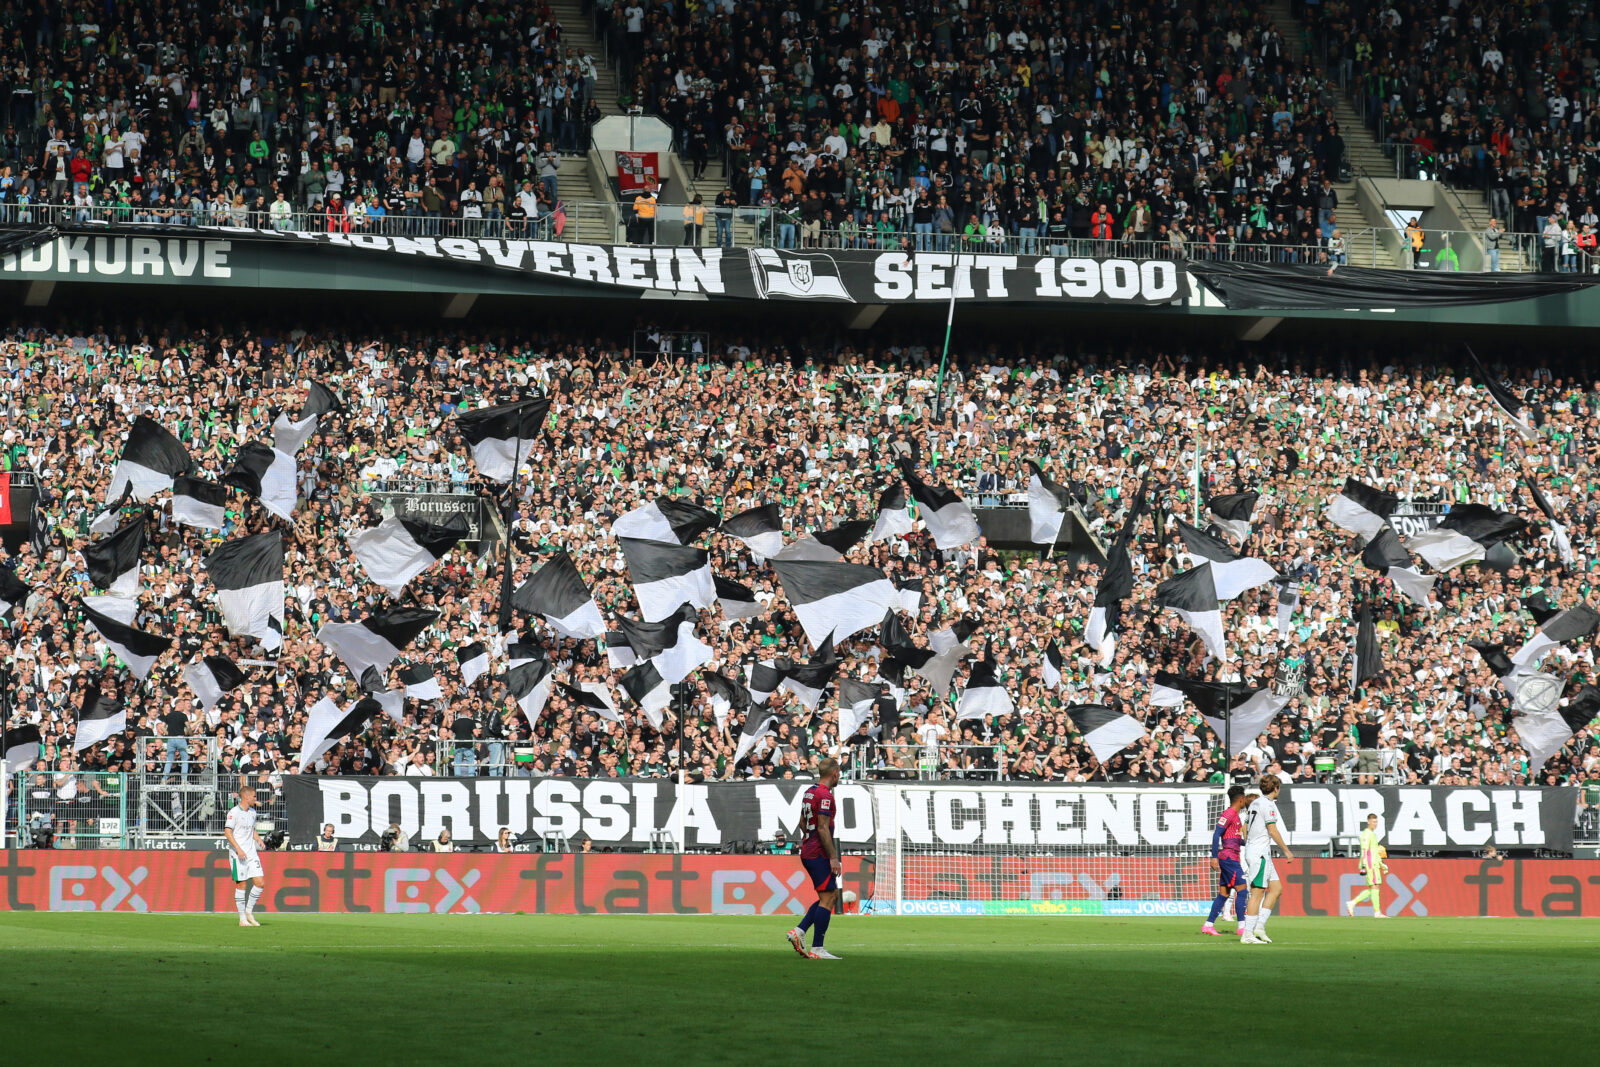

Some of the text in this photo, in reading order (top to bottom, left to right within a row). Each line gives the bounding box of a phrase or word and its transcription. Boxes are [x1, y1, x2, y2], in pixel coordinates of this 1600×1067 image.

[874, 252, 1017, 300] SEIT
[1034, 257, 1178, 301] 1900
[404, 497, 475, 513] Borussen
[318, 779, 721, 845] BORUSSIA
[902, 901, 962, 914] ONGEN
[1134, 901, 1200, 914] JONGEN
